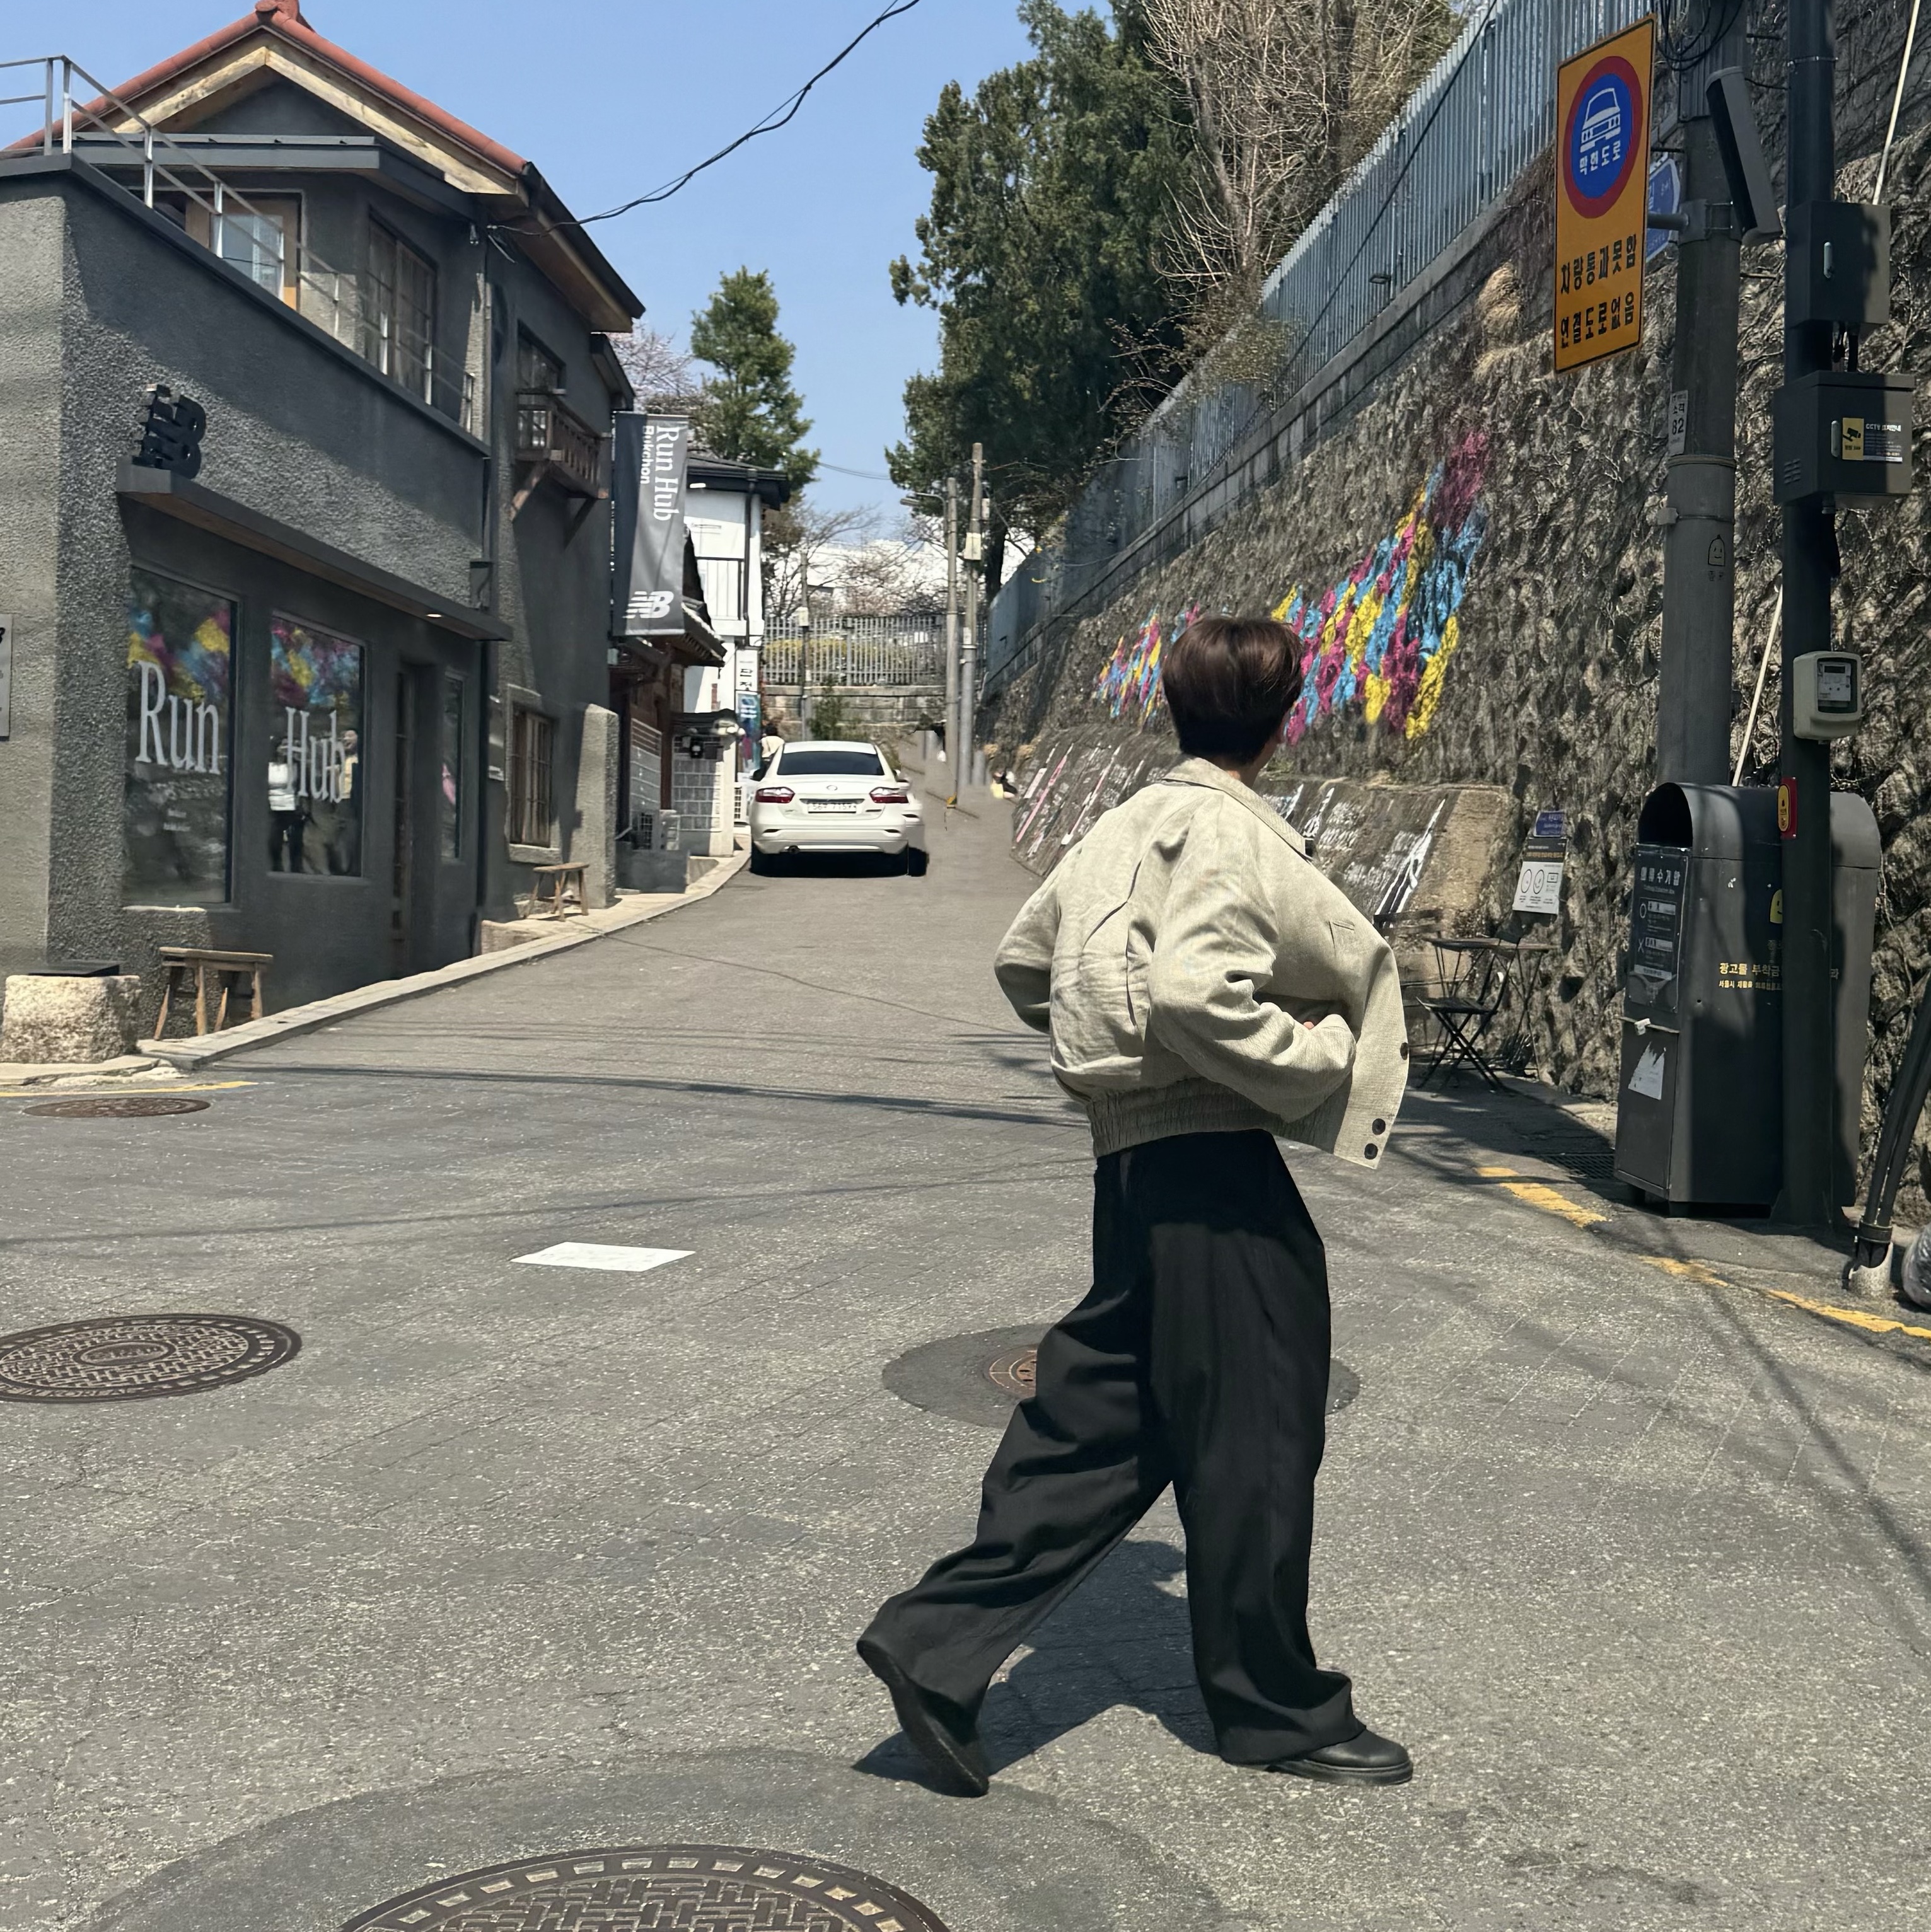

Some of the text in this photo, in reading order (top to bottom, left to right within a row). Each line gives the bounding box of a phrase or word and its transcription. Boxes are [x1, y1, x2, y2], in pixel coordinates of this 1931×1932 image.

[1560, 234, 1637, 295] 차량통과못함
[1560, 292, 1635, 349] 연결도로없음
[640, 424, 655, 485] Bukchon
[1672, 417, 1684, 435] 82
[653, 425, 680, 521] Run Hub
[134, 659, 347, 804] Run Hub
[1719, 963, 1780, 977] 광고물 부착금
